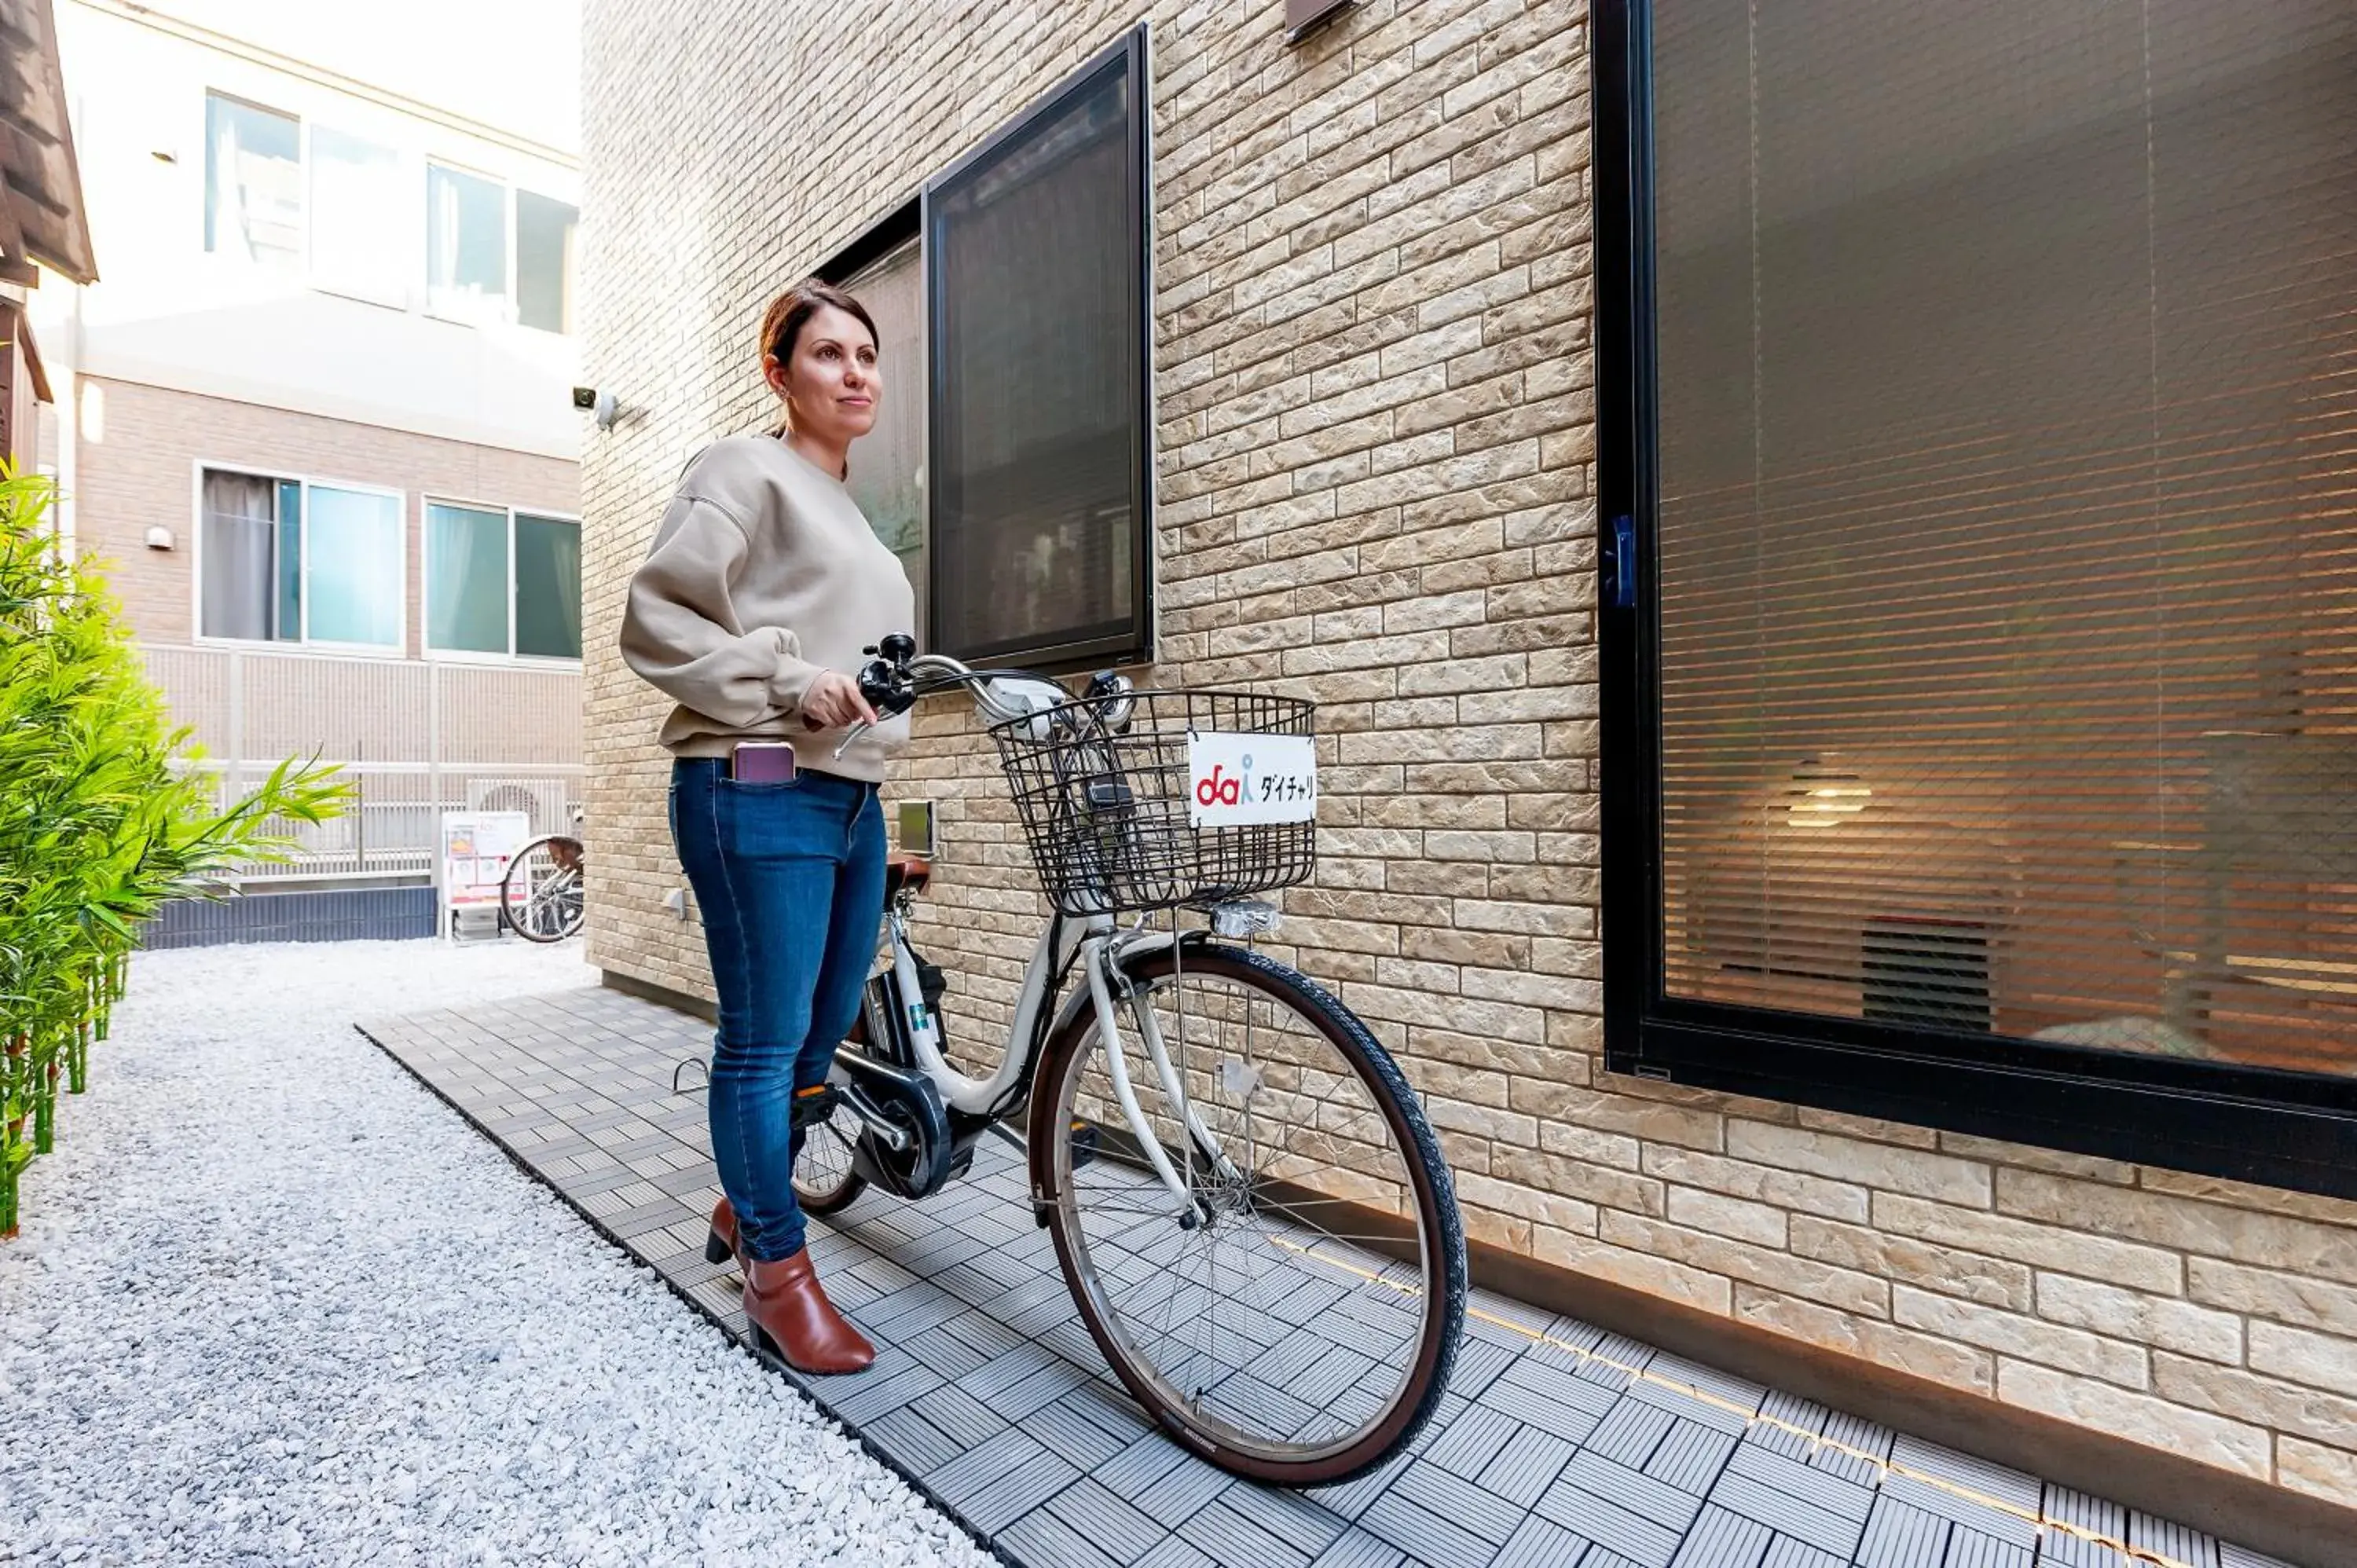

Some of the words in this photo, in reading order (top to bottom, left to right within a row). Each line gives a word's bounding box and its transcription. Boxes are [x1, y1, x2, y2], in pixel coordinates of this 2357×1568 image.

[1197, 753, 1254, 806] dai
[1261, 774, 1313, 803] ダイチャリ
